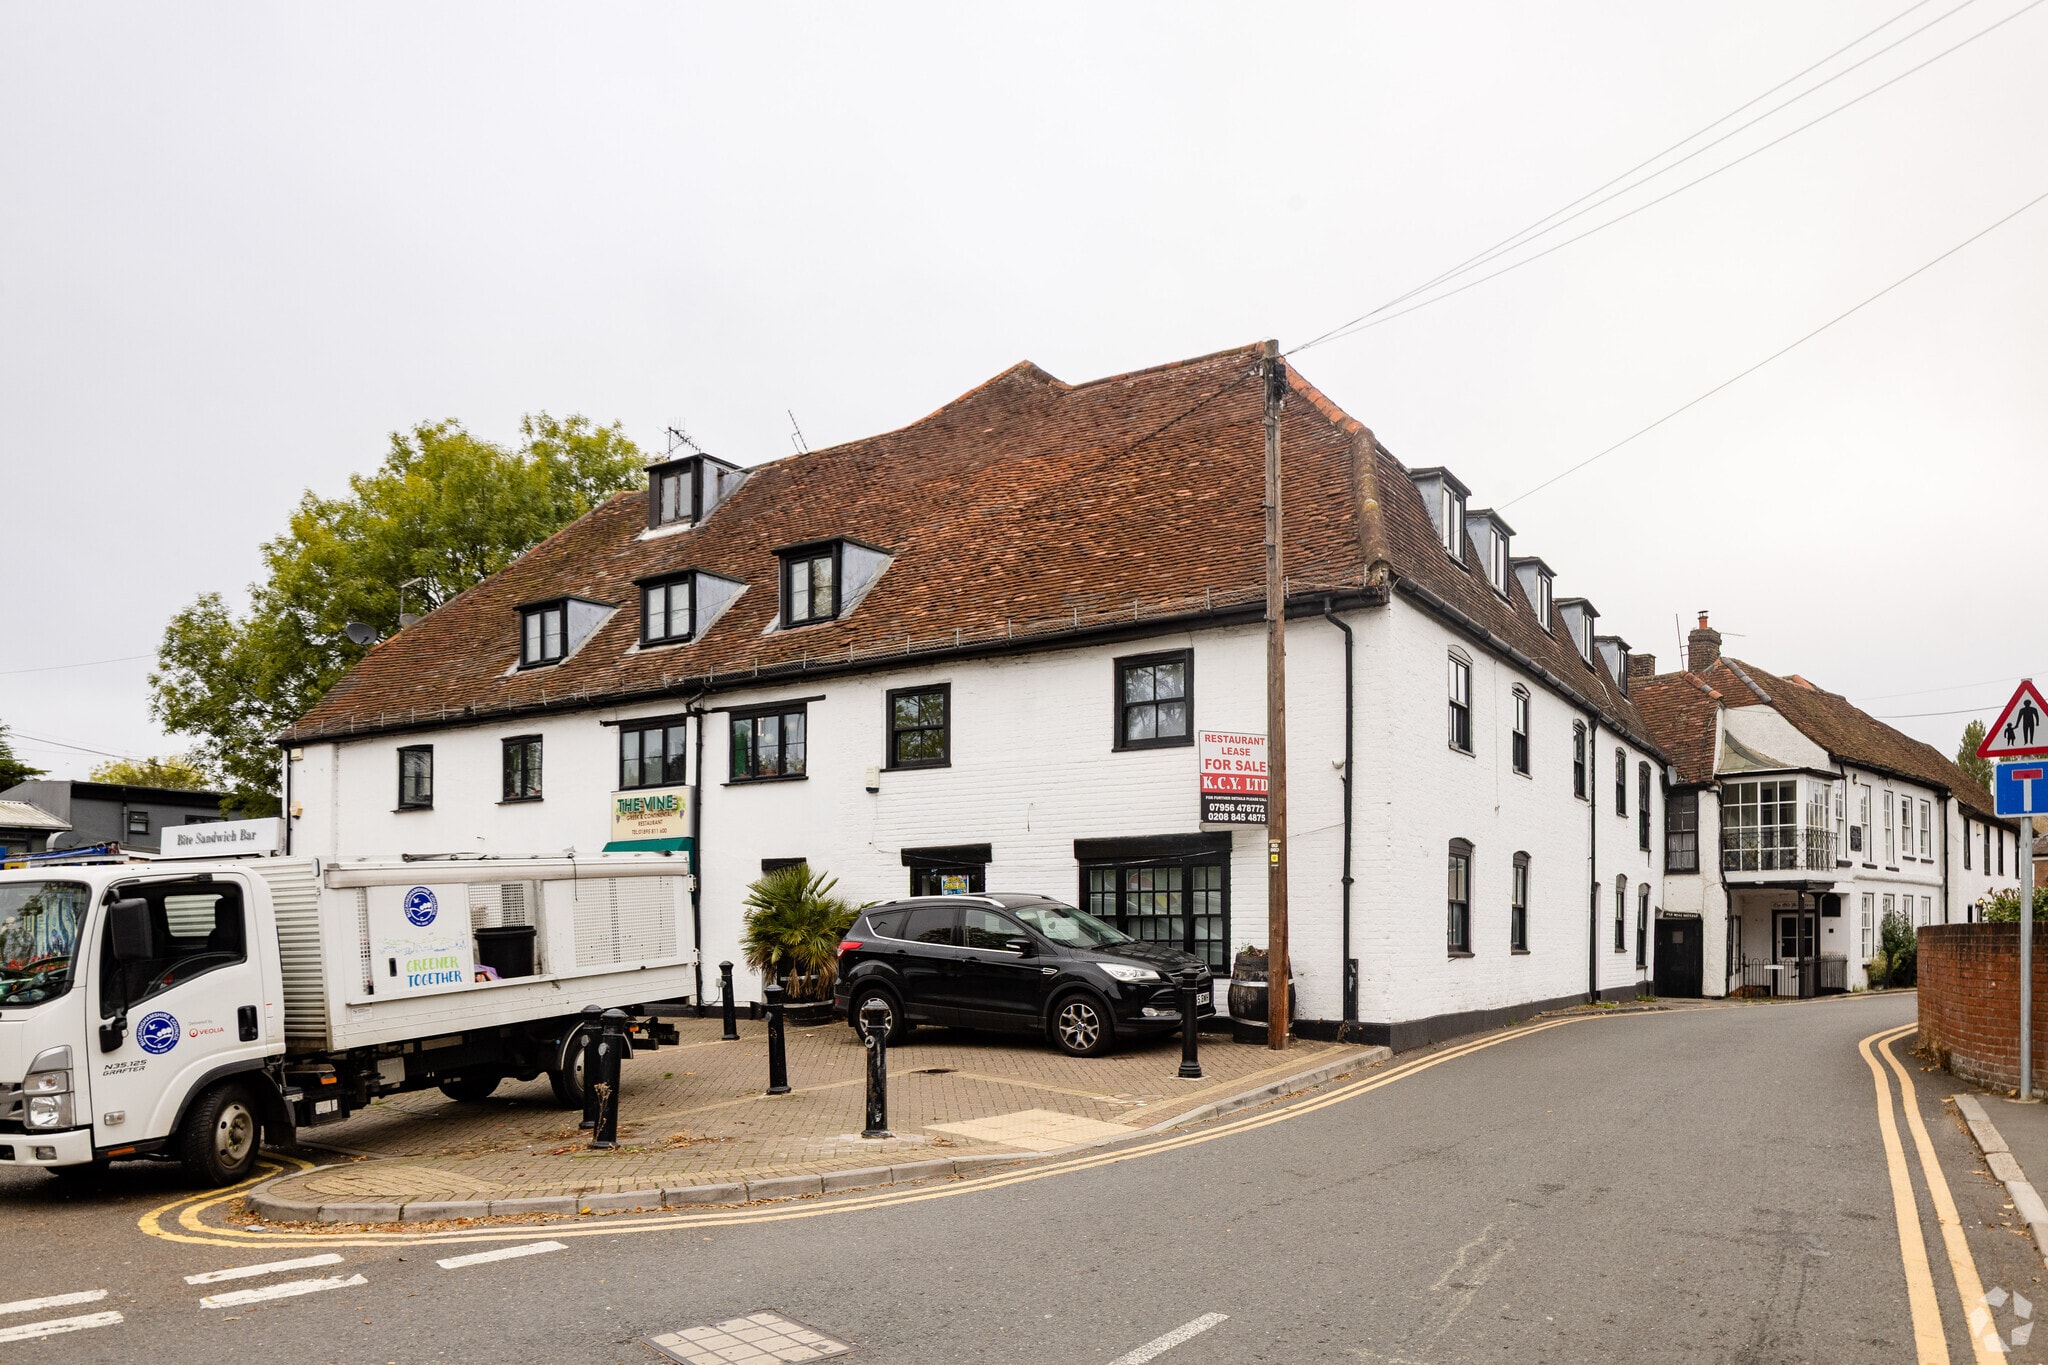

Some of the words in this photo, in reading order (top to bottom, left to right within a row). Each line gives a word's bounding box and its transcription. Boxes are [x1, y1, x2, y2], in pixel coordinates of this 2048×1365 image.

[1205, 734, 1265, 745] RESTAURANT
[1221, 747, 1251, 756] LEASE
[1205, 758, 1231, 770] FOR
[1235, 760, 1266, 772] SALE
[1203, 776, 1241, 790] K.C.Y.
[1245, 778, 1268, 791] LTD
[617, 798, 642, 812] THE
[643, 794, 676, 810] VINE
[1209, 803, 1235, 812] 07956
[1236, 803, 1265, 813] 478772
[644, 811, 672, 819] CONTINENTAL
[1208, 812, 1229, 821] 0208
[1230, 813, 1246, 821] 845
[1247, 813, 1266, 822] 4875
[177, 833, 193, 846] Bite
[195, 829, 237, 844] Sandwich
[239, 828, 257, 841] Bar
[405, 956, 459, 973] GREENER
[407, 970, 463, 988] TOGETHER
[137, 1012, 171, 1047] BUCKINGHAMSHIRE
[170, 1017, 180, 1041] COUNCIL
[199, 1026, 224, 1035] VEOLIA
[105, 1059, 147, 1069] N35.125
[103, 1066, 146, 1076] GRAFTER
